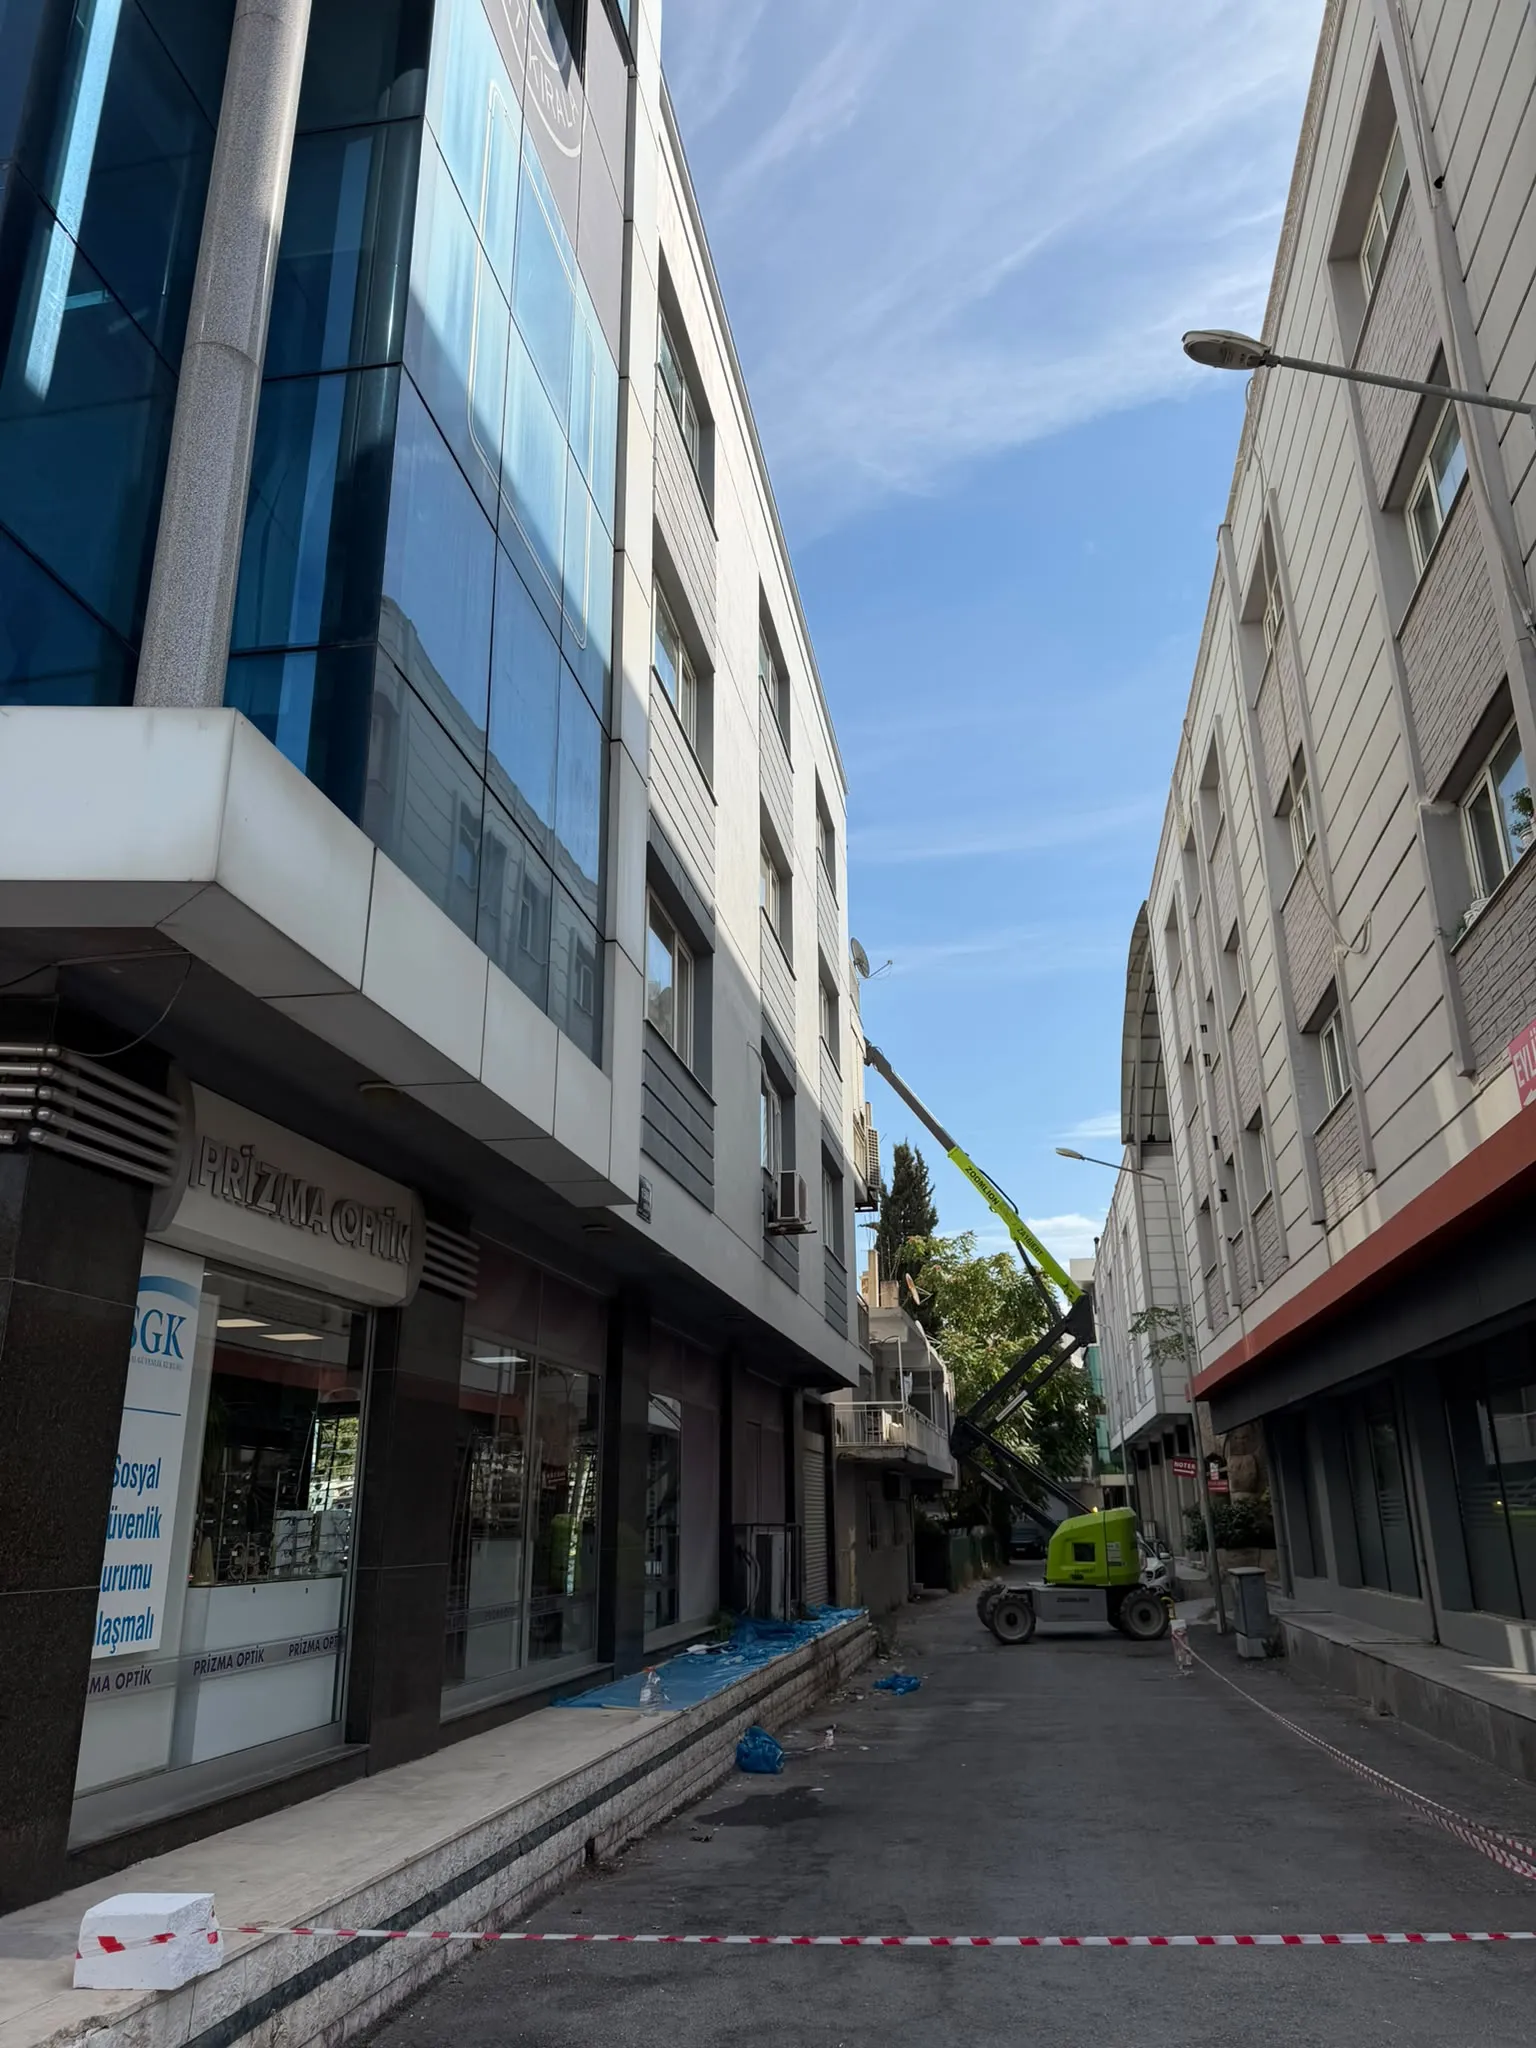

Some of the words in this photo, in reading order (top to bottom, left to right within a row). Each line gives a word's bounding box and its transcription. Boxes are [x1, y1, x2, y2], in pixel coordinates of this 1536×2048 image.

[189, 1136, 328, 1235] PRİZMA
[330, 1198, 411, 1264] OPTİK
[965, 1166, 999, 1205] ZOOMLION
[112, 1454, 162, 1496] Sosyal
[1174, 1461, 1196, 1470] NOTER
[106, 1504, 162, 1540] üvenlik
[102, 1562, 153, 1593] urumu
[96, 1606, 155, 1655] laşmalı
[288, 1638, 321, 1657] PRİZMA
[323, 1636, 339, 1650] OPT
[193, 1650, 233, 1676] PRİZMA
[236, 1645, 265, 1668] OPTİK
[89, 1675, 110, 1695] MA
[115, 1665, 152, 1690] OPTİK
